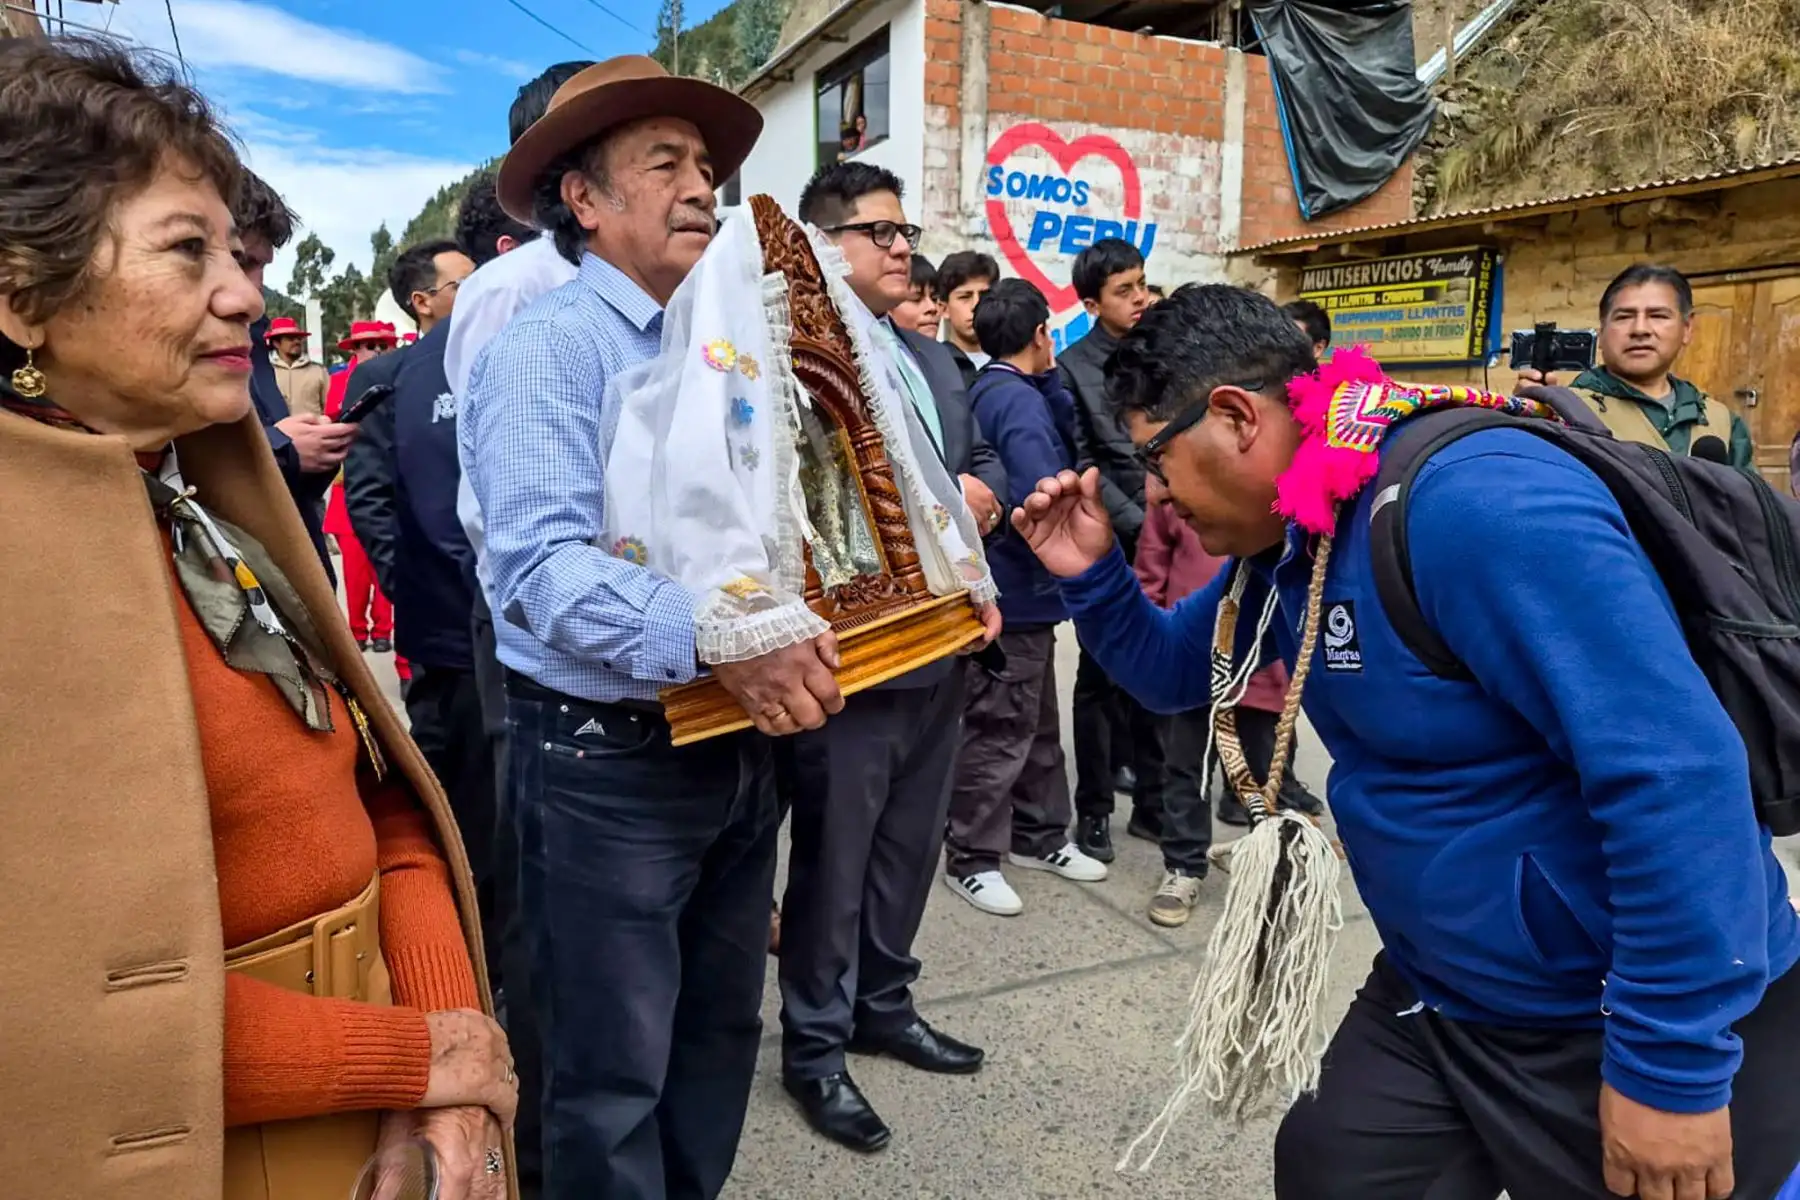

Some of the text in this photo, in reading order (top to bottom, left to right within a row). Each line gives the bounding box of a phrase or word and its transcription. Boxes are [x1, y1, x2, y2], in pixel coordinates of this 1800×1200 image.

[986, 165, 1089, 206] SOMOS
[1303, 258, 1423, 289] MULTISERVICIOS
[1408, 305, 1465, 319] LLANTAS
[1473, 252, 1492, 356] LUBRICANTES
